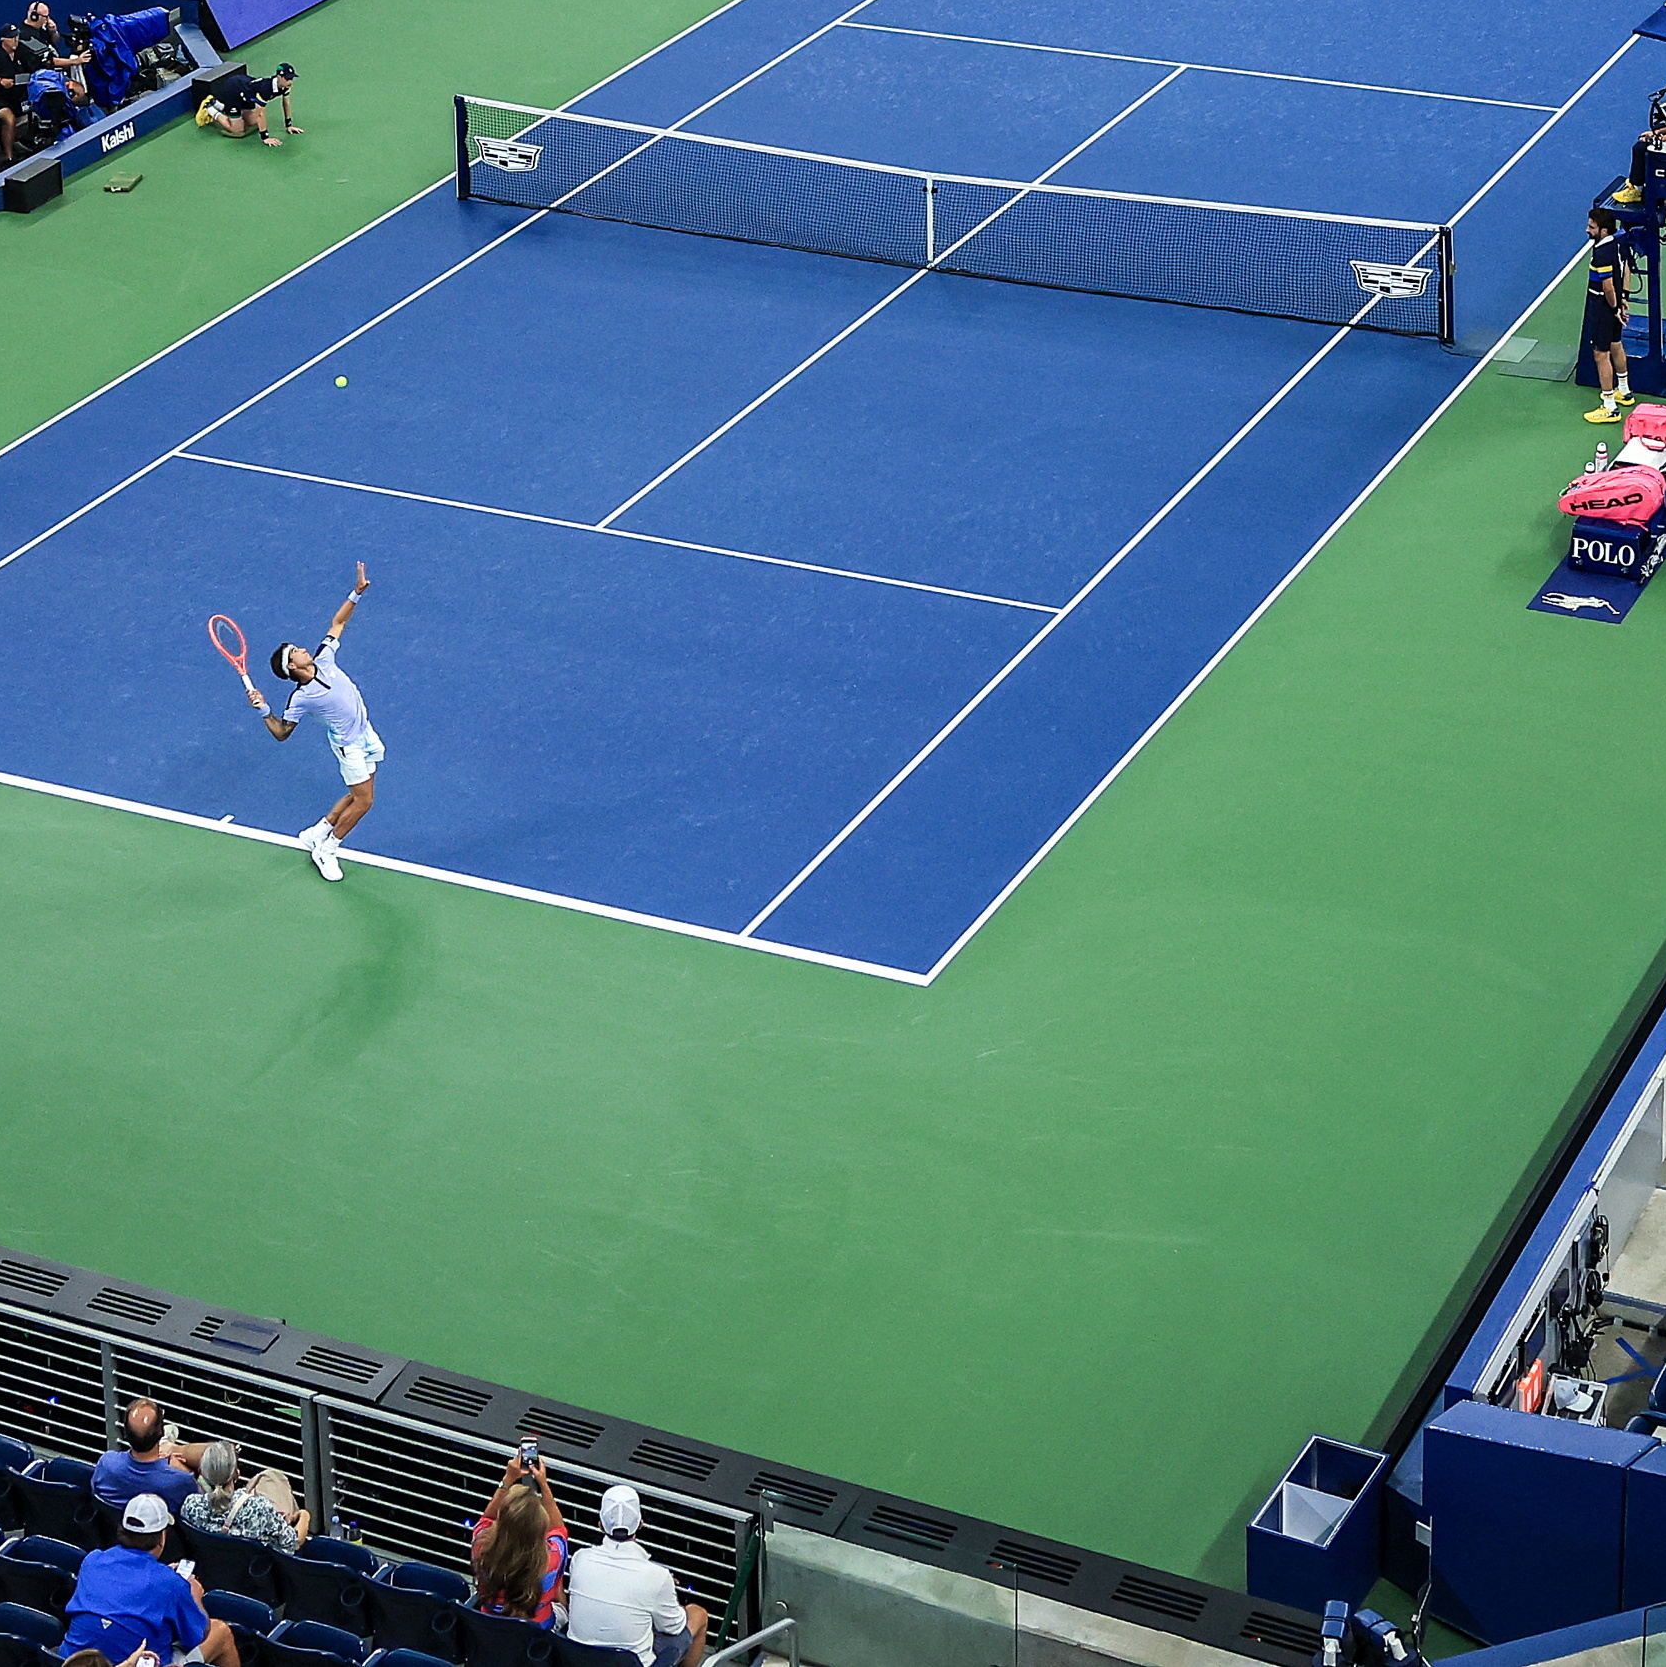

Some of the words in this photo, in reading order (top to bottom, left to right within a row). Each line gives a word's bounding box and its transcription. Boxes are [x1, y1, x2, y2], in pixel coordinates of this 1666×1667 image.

[101, 121, 135, 153] Kalshi
[1569, 492, 1643, 512] HEAD
[1571, 537, 1635, 567] POLO
